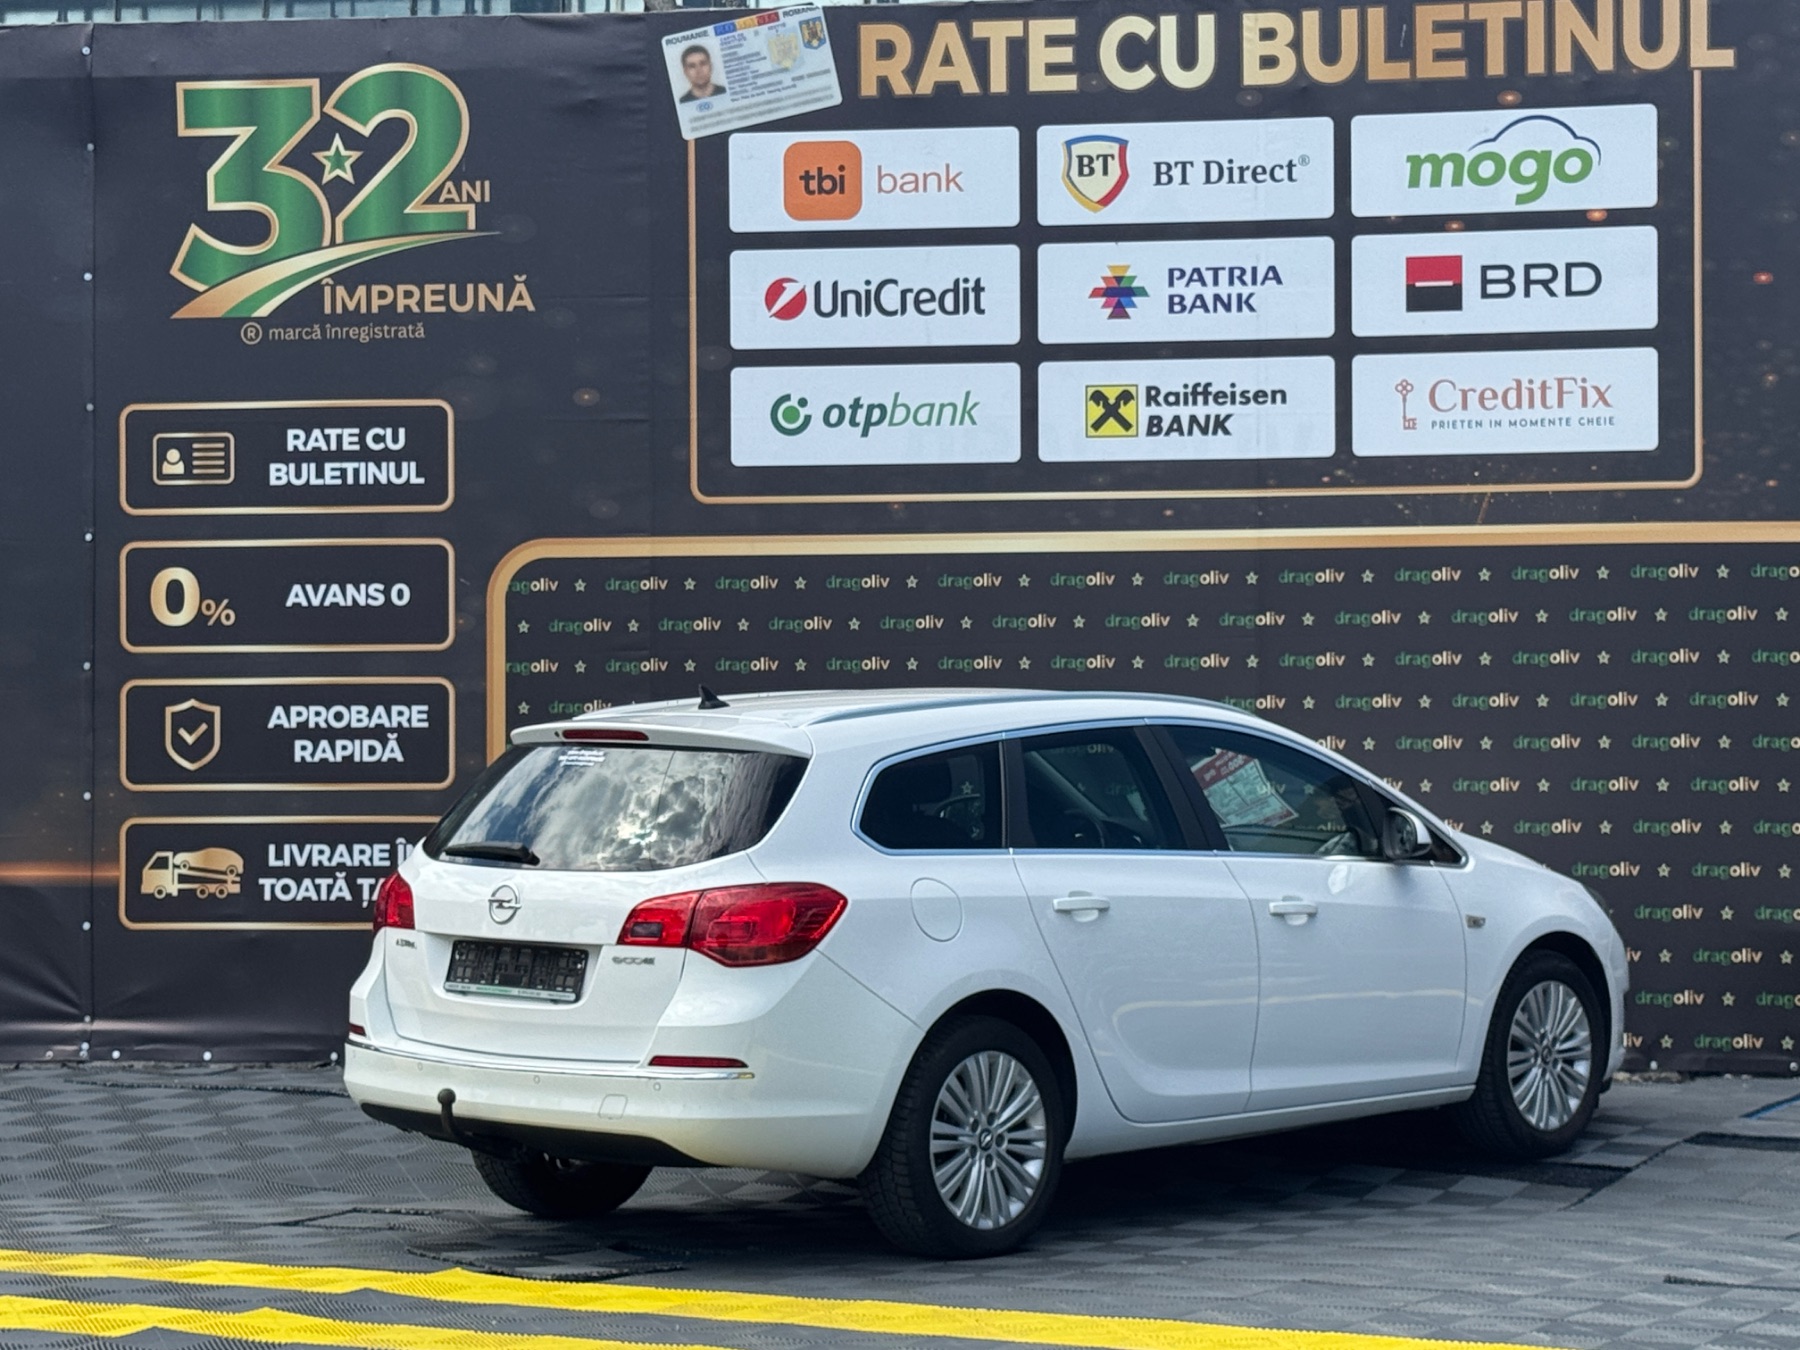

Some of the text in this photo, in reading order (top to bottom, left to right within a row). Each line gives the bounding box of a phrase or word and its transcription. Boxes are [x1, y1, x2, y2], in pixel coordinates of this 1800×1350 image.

[665, 29, 710, 46] ROUMANIE
[859, 17, 1079, 97] RATE
[1099, 14, 1216, 92] CU
[1241, 0, 1736, 86] BULETINUL
[170, 62, 476, 292] 32
[1076, 153, 1115, 177] BT
[1153, 161, 1194, 186] BT
[1406, 147, 1593, 206] mogo
[439, 180, 490, 203] ANI
[799, 163, 964, 196] tbi bank
[1168, 265, 1283, 288] PATRIA
[1480, 261, 1602, 299] BRD
[321, 275, 536, 315] ÎMPREUNĂ
[814, 277, 985, 318] UniCredit
[1168, 292, 1257, 315] BANK
[269, 323, 321, 342] marcă
[325, 322, 425, 343] înregistrată
[1145, 382, 1287, 408] Raiffeisen
[1428, 377, 1613, 413] CreditFix
[822, 390, 980, 438] otpbank
[1145, 413, 1234, 438] BANK
[1431, 416, 1615, 430] PRIETEN IN MOMENTE CHEIE
[286, 427, 406, 451] RATE CU
[269, 461, 425, 486] BULETINUL
[509, 563, 1800, 595] agoliv dragoliv dragoliv dragoliv dragoliv dragoliv dragoliv dragoliv dragoliv dragoliv dragoliv drago
[285, 583, 410, 607] AVANS 0
[549, 606, 1758, 635] dragoliv dragoliv dragoliv dragoliv dragoliv dragoliv dragoliv dragoliv dragoliv dragoliv dragoliv
[506, 648, 1800, 675] ragoliv dragoliv dragoliv dragoliv dragoliv dragoliv dragoliv dragoliv dragoliv dragoliv dragoliv drago
[1336, 693, 1402, 711] dragoliv
[1452, 692, 1519, 710] dragoliv
[1569, 691, 1638, 709] dragoliv
[1690, 691, 1759, 709] dragoliv
[267, 705, 429, 729] APROBARE
[294, 733, 404, 762] RAPIDĂ
[1396, 735, 1463, 752] dragoliv
[1513, 734, 1581, 751] dragoliv
[1632, 733, 1701, 751] dragoliv
[1753, 734, 1800, 751] drago
[1453, 776, 1760, 794] dragoliv dragoliv dragoliv
[1514, 818, 1800, 837] dragoliv dragoliv drago
[268, 843, 391, 867] LIVRARE
[1572, 861, 1761, 880] dragoliv dragoliv
[258, 873, 352, 901] TOATĂ
[1635, 904, 1703, 921] dragoliv
[1693, 948, 1762, 966] dragoliv
[1635, 989, 1704, 1007] dragoliv
[1694, 1033, 1764, 1051] dragoliv
